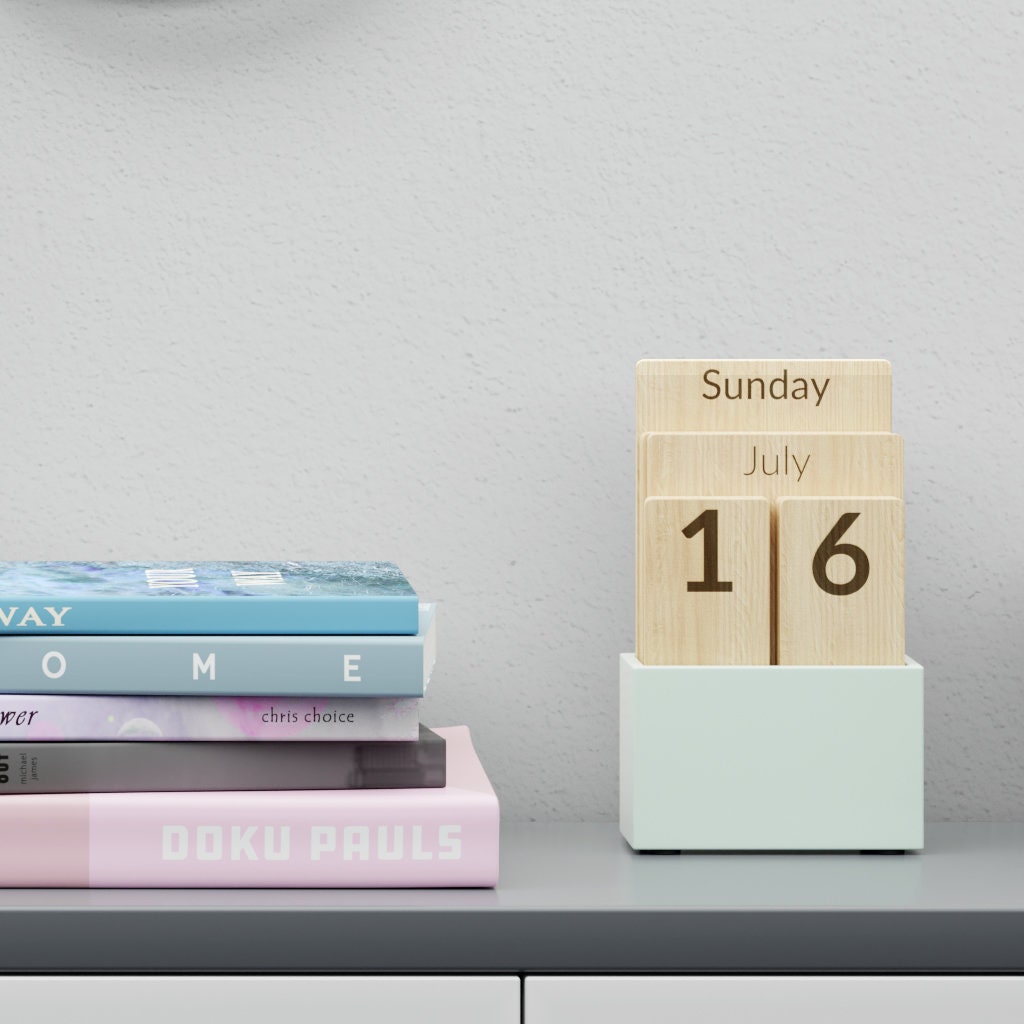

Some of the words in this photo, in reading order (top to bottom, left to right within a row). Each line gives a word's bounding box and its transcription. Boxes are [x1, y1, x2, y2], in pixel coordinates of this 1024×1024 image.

[702, 369, 830, 407] Sunday
[744, 445, 811, 482] July
[261, 705, 298, 724] chris
[303, 705, 356, 724] choice
[20, 752, 28, 785] michael
[31, 756, 39, 782] james
[162, 825, 290, 861] DOKU
[311, 825, 462, 861] PAULS
